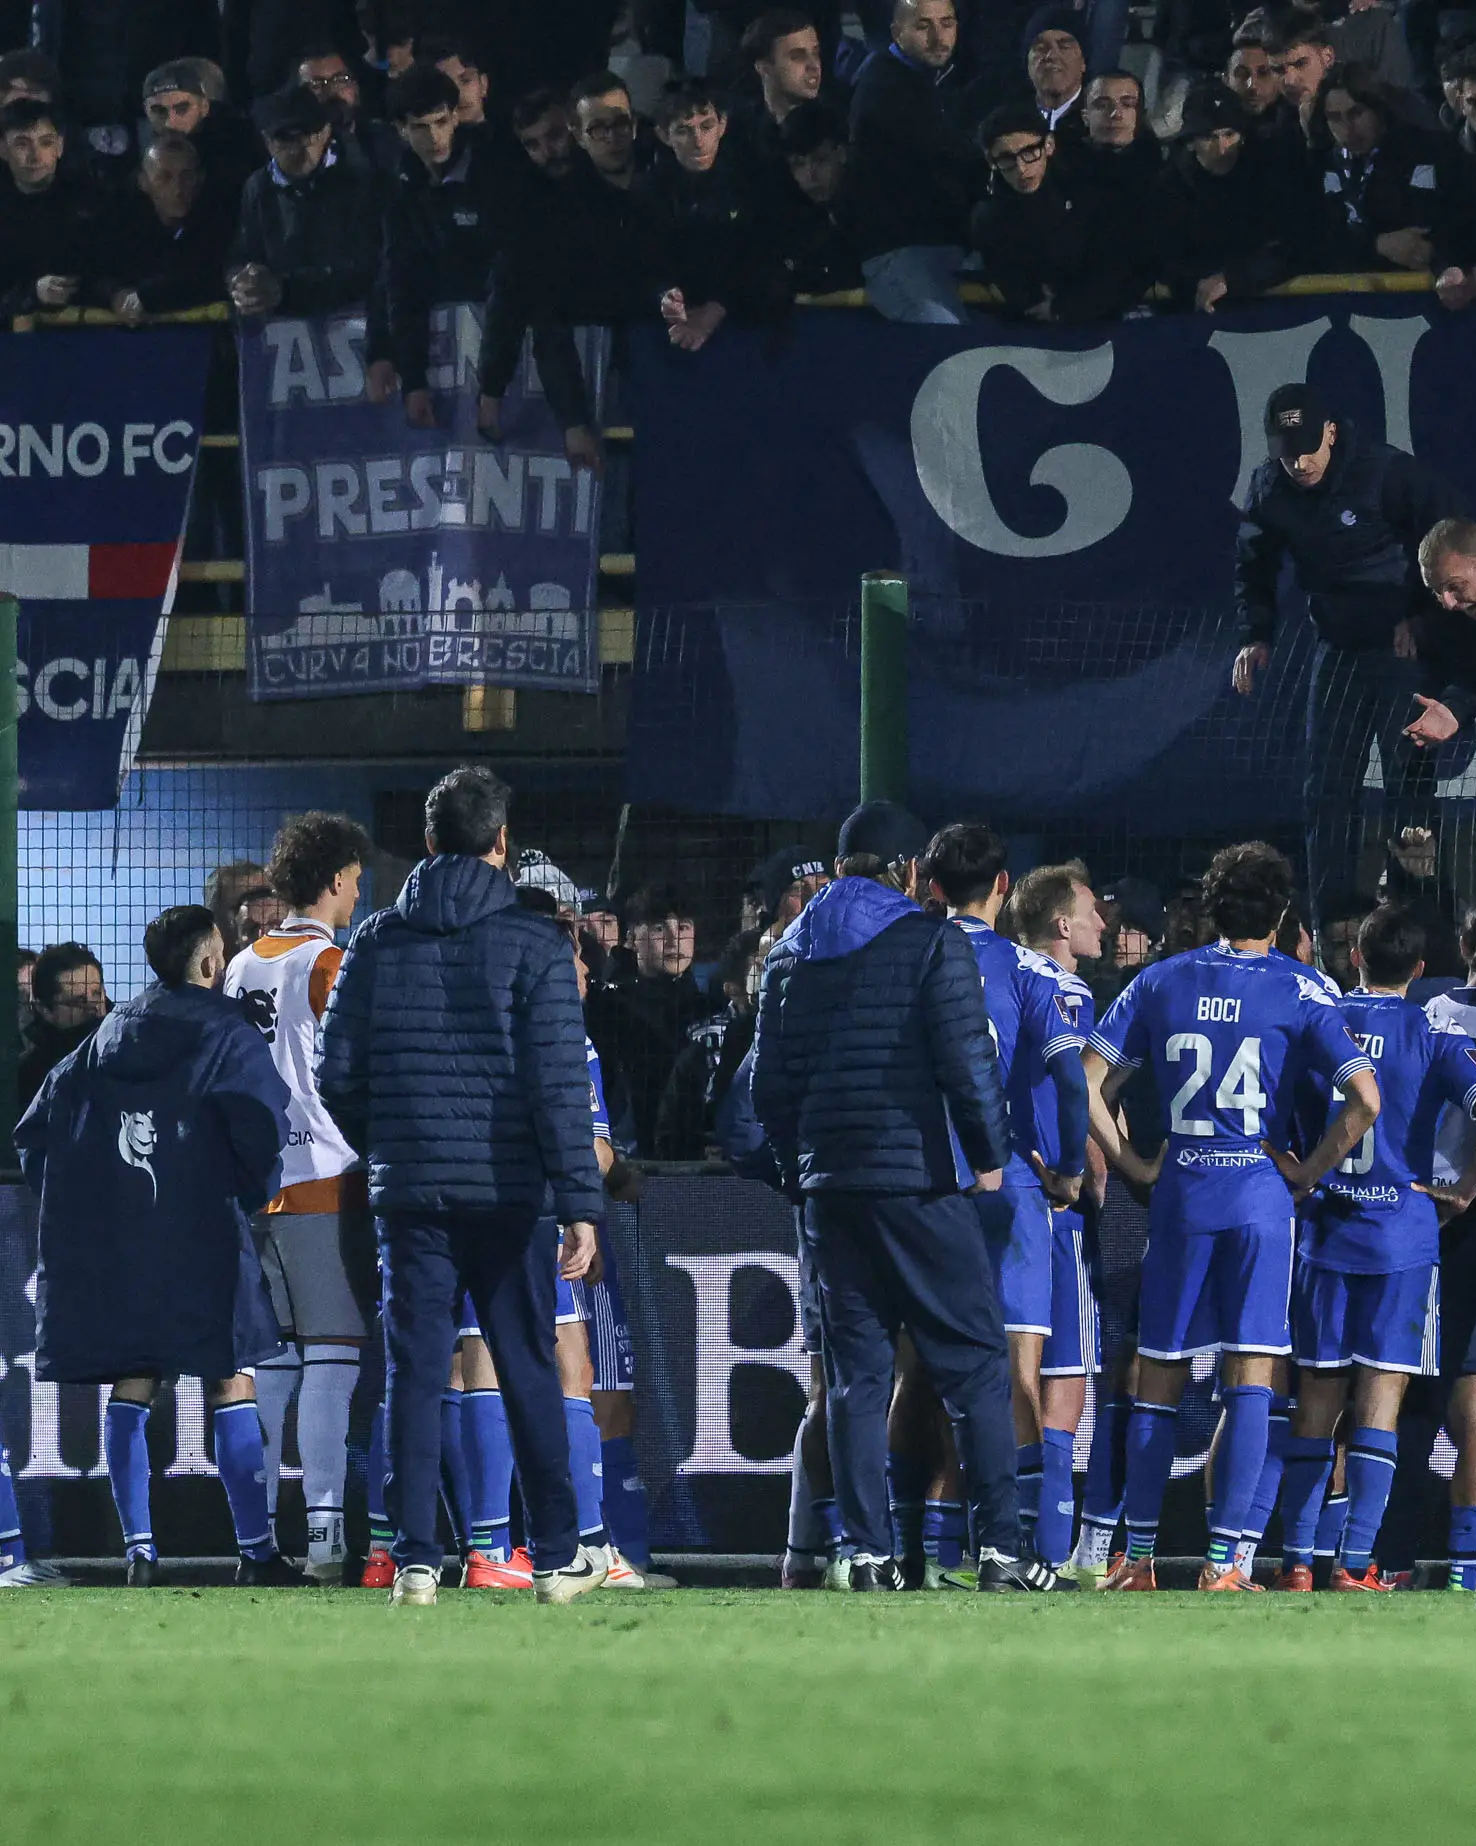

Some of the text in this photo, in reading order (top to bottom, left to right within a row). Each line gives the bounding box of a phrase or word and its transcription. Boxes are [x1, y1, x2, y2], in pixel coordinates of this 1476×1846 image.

[123, 419, 194, 477] FC
[1197, 997, 1241, 1024] BOCI
[1166, 1033, 1267, 1137] 24
